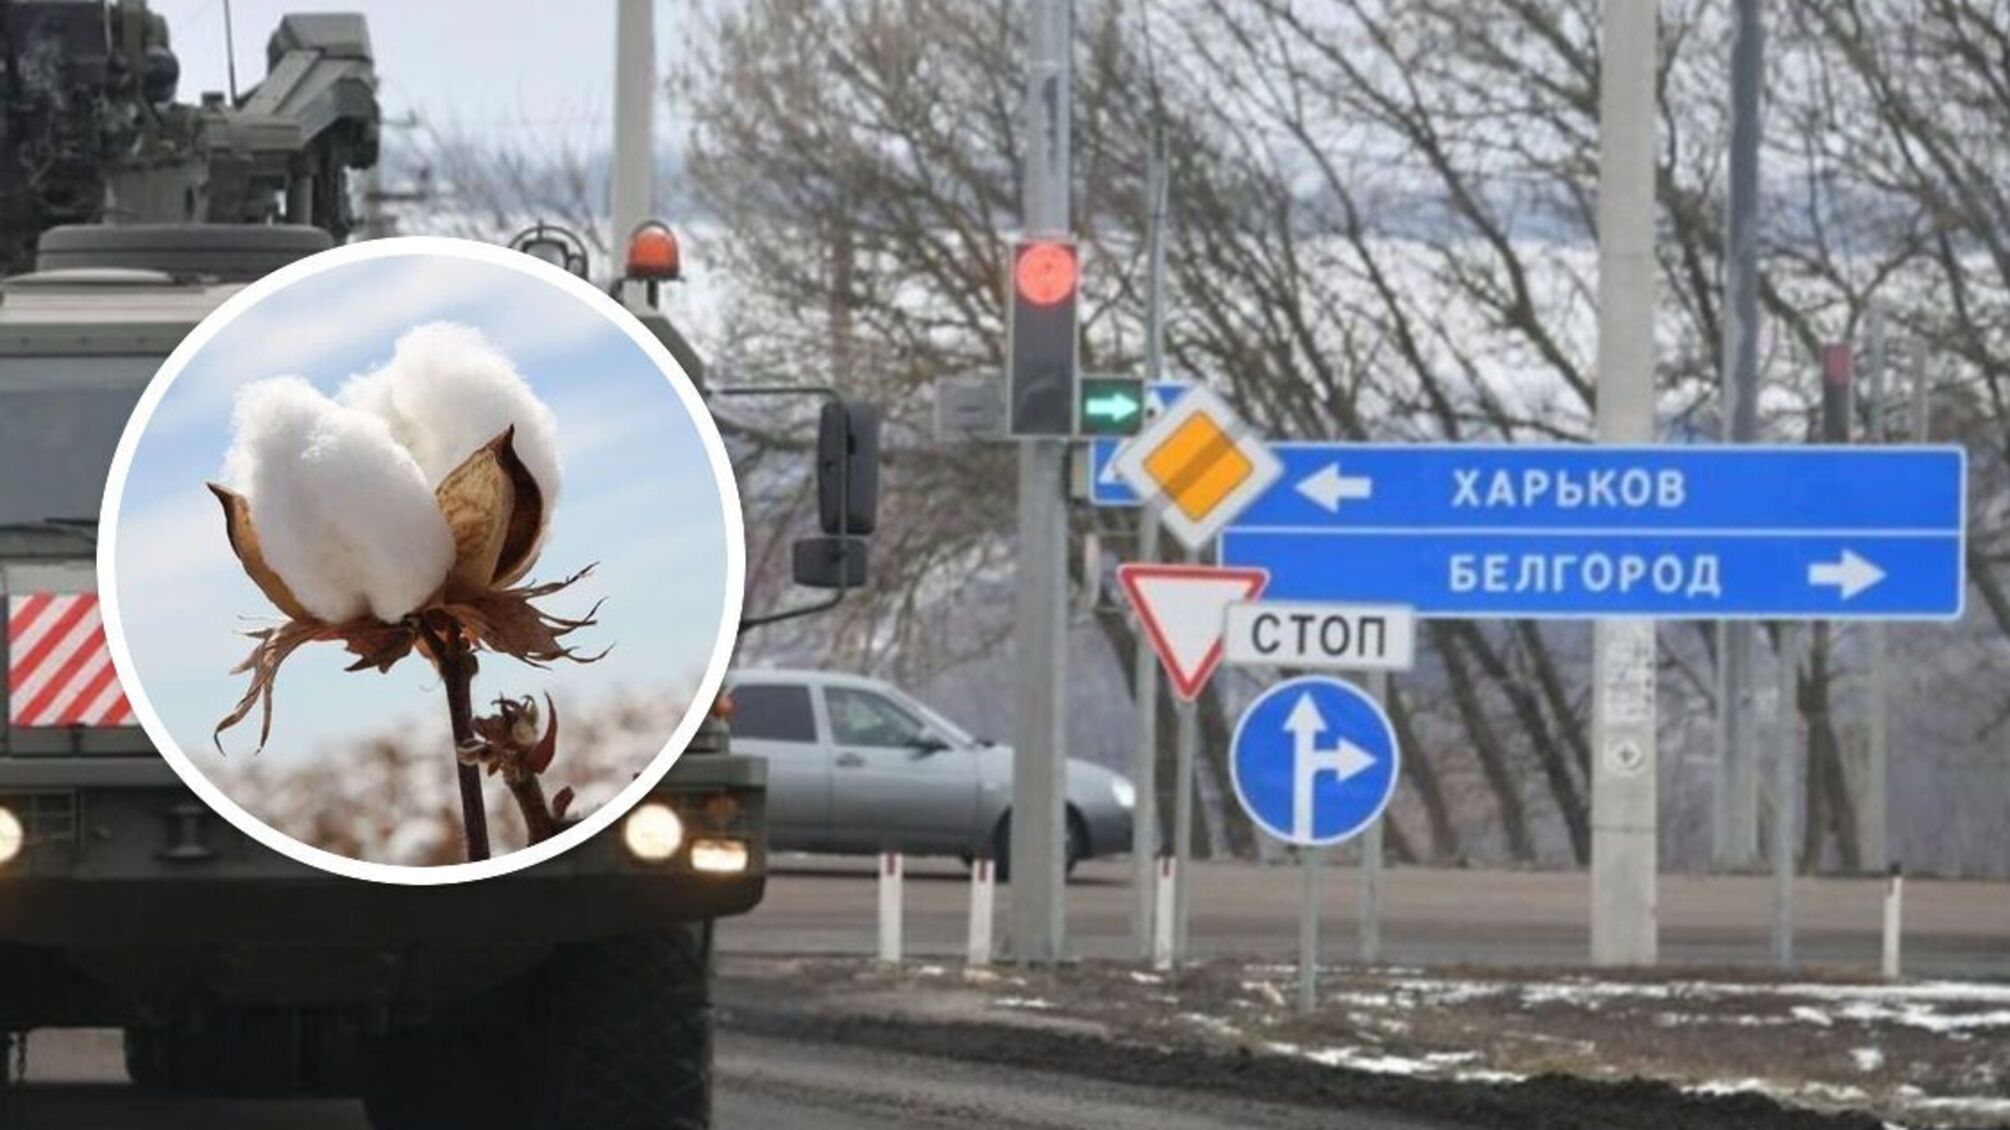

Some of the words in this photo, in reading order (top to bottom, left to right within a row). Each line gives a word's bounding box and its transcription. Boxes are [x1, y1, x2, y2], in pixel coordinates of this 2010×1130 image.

[1453, 469, 1685, 507] ХАРЬКОВ
[1449, 553, 1721, 597] БЕЛГОРОД
[1250, 613, 1387, 657] СТОП
